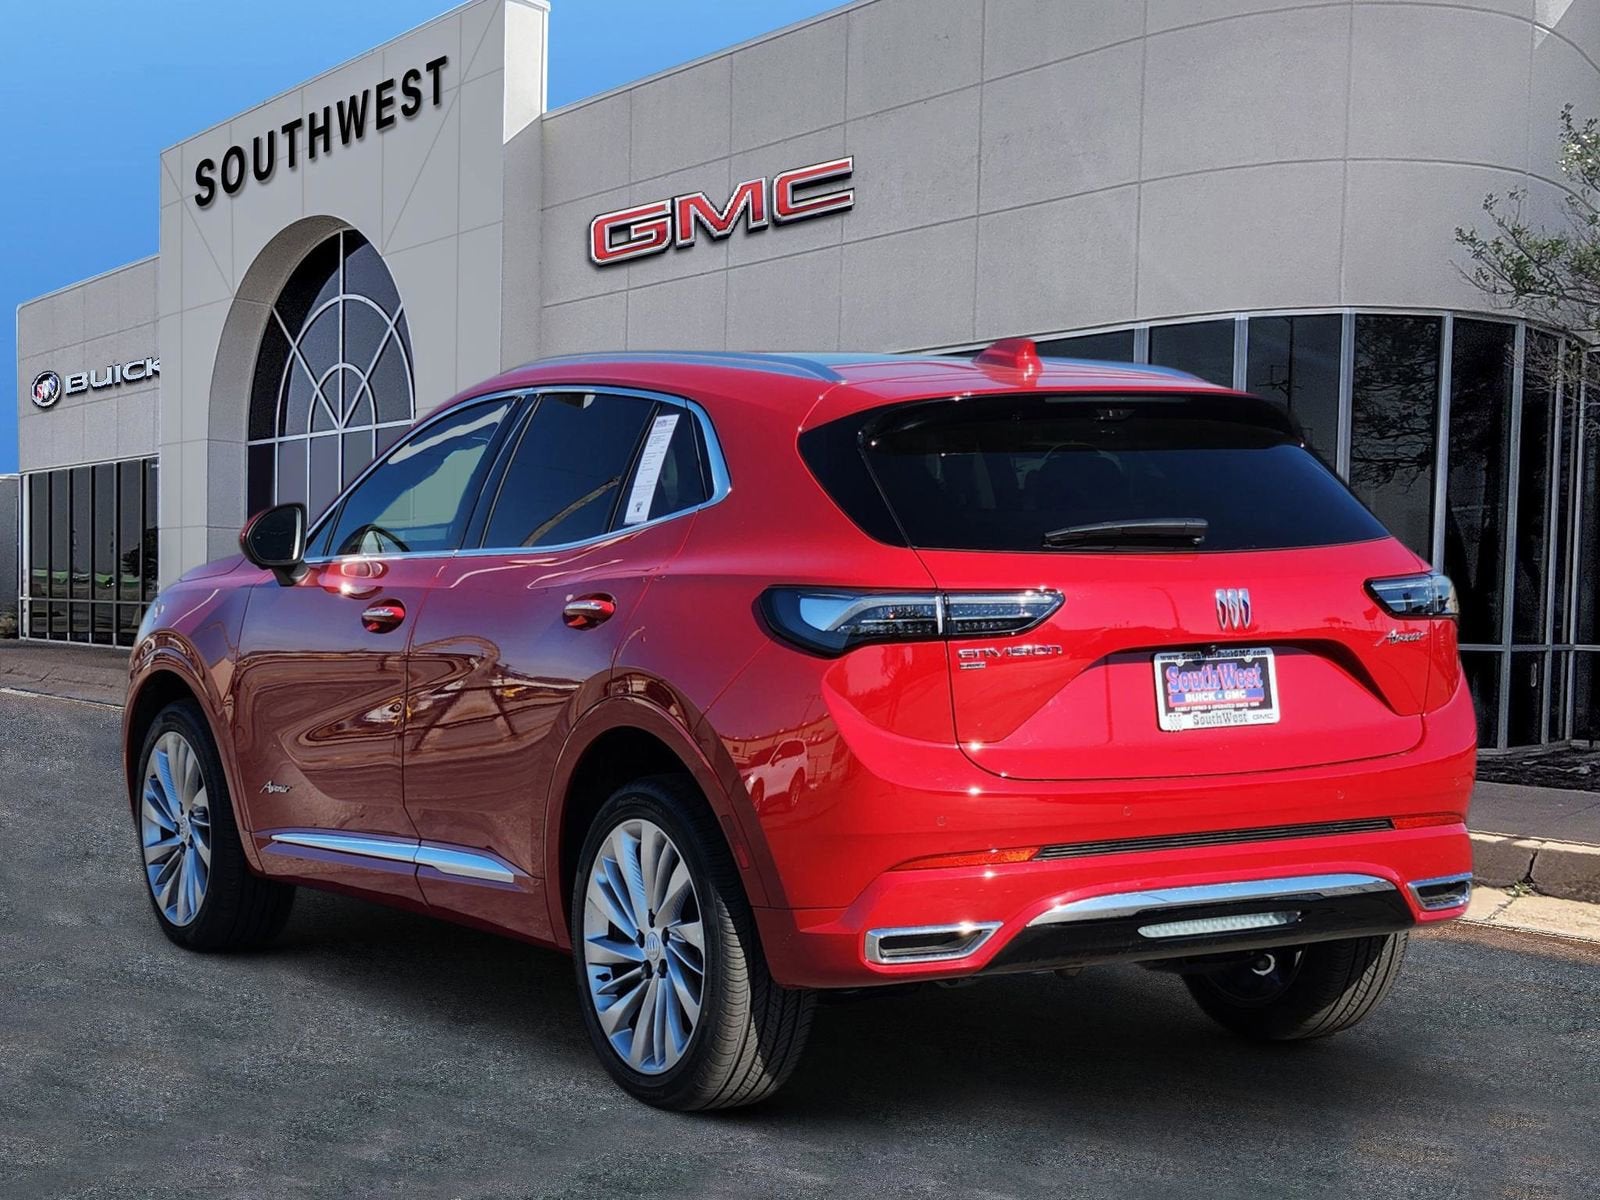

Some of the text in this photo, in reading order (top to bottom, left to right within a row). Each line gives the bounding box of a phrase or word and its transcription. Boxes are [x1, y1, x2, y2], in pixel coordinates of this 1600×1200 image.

[194, 55, 448, 207] SOUTHWEST
[590, 156, 854, 265] GMC
[64, 357, 159, 396] BUICK
[1166, 663, 1263, 693] SouthWest
[1185, 689, 1247, 702] BUICK GMC
[1193, 711, 1274, 725] SouthWest GMC
